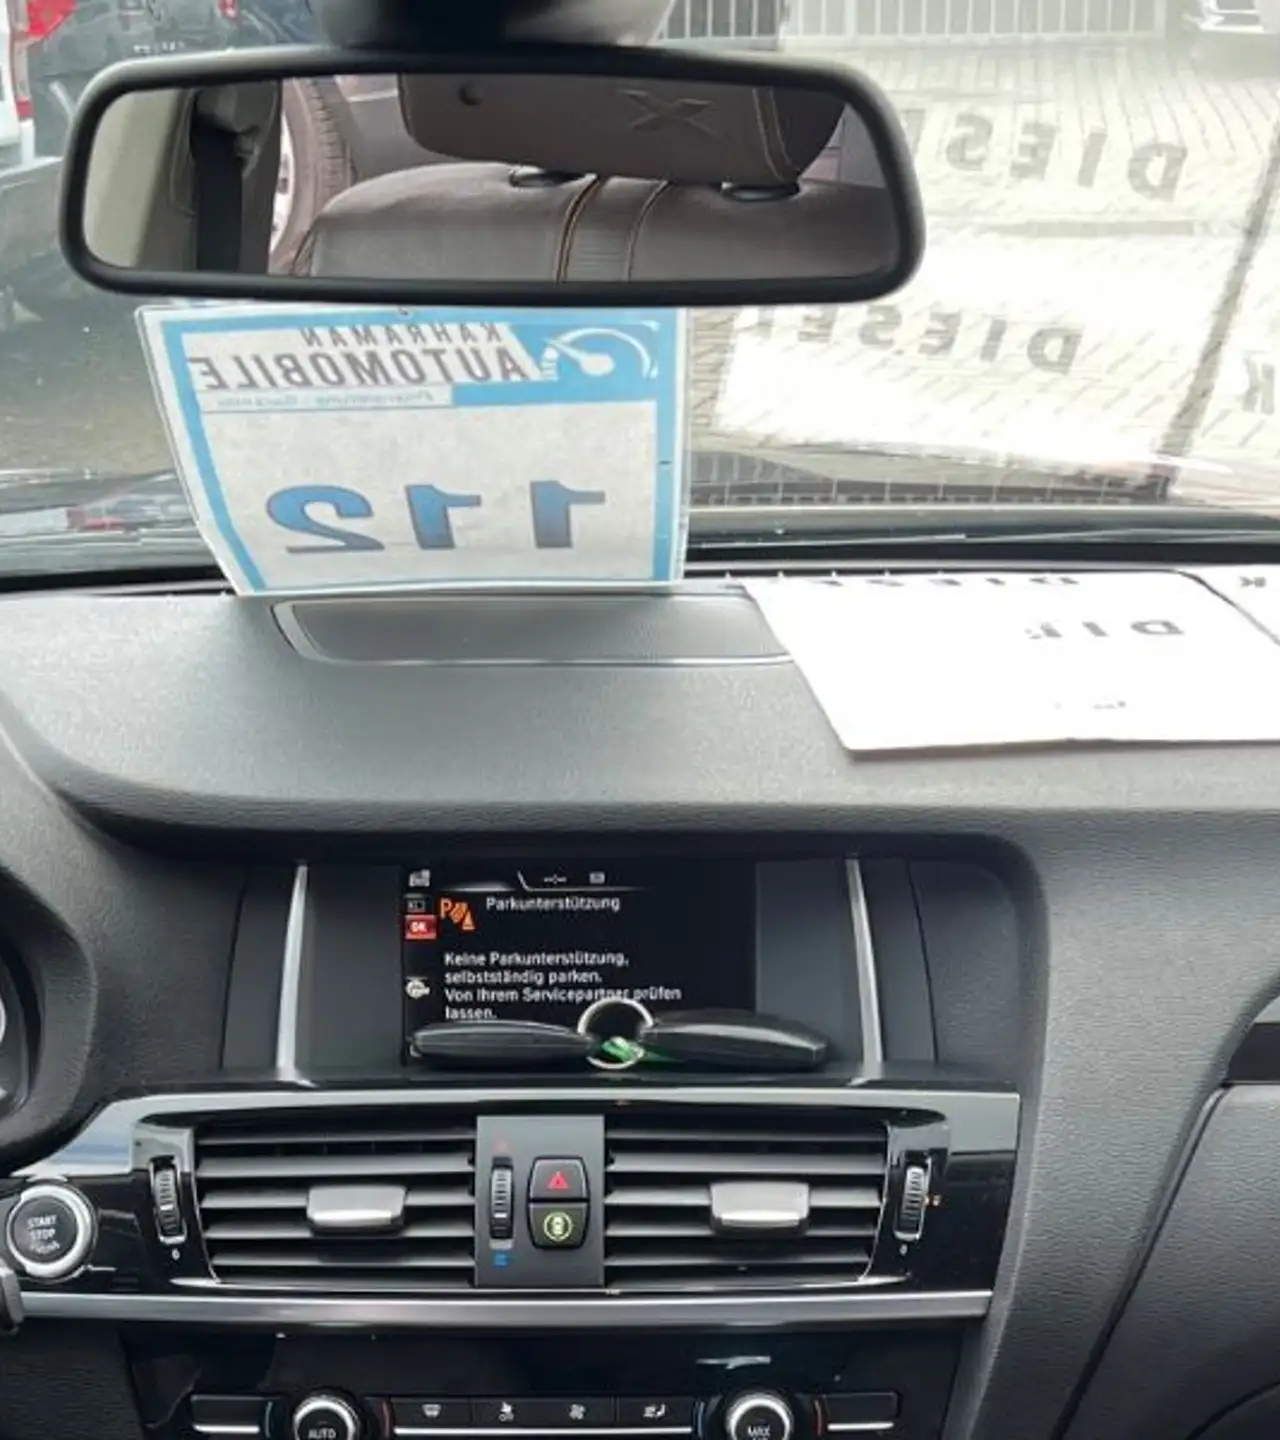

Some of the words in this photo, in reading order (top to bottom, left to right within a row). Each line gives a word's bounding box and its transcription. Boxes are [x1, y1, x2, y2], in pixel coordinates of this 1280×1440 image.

[486, 896, 621, 913] Parkunterstützung
[444, 952, 486, 966] Keine
[444, 970, 545, 985] selbstständig
[548, 970, 602, 985] parken.
[444, 988, 473, 1001] Von
[477, 987, 519, 1001] Ihrem
[522, 987, 629, 1003] Servicepartner
[633, 986, 682, 1001] prüfen
[444, 1005, 498, 1019] lassen.
[308, 1428, 336, 1440] AUTO
